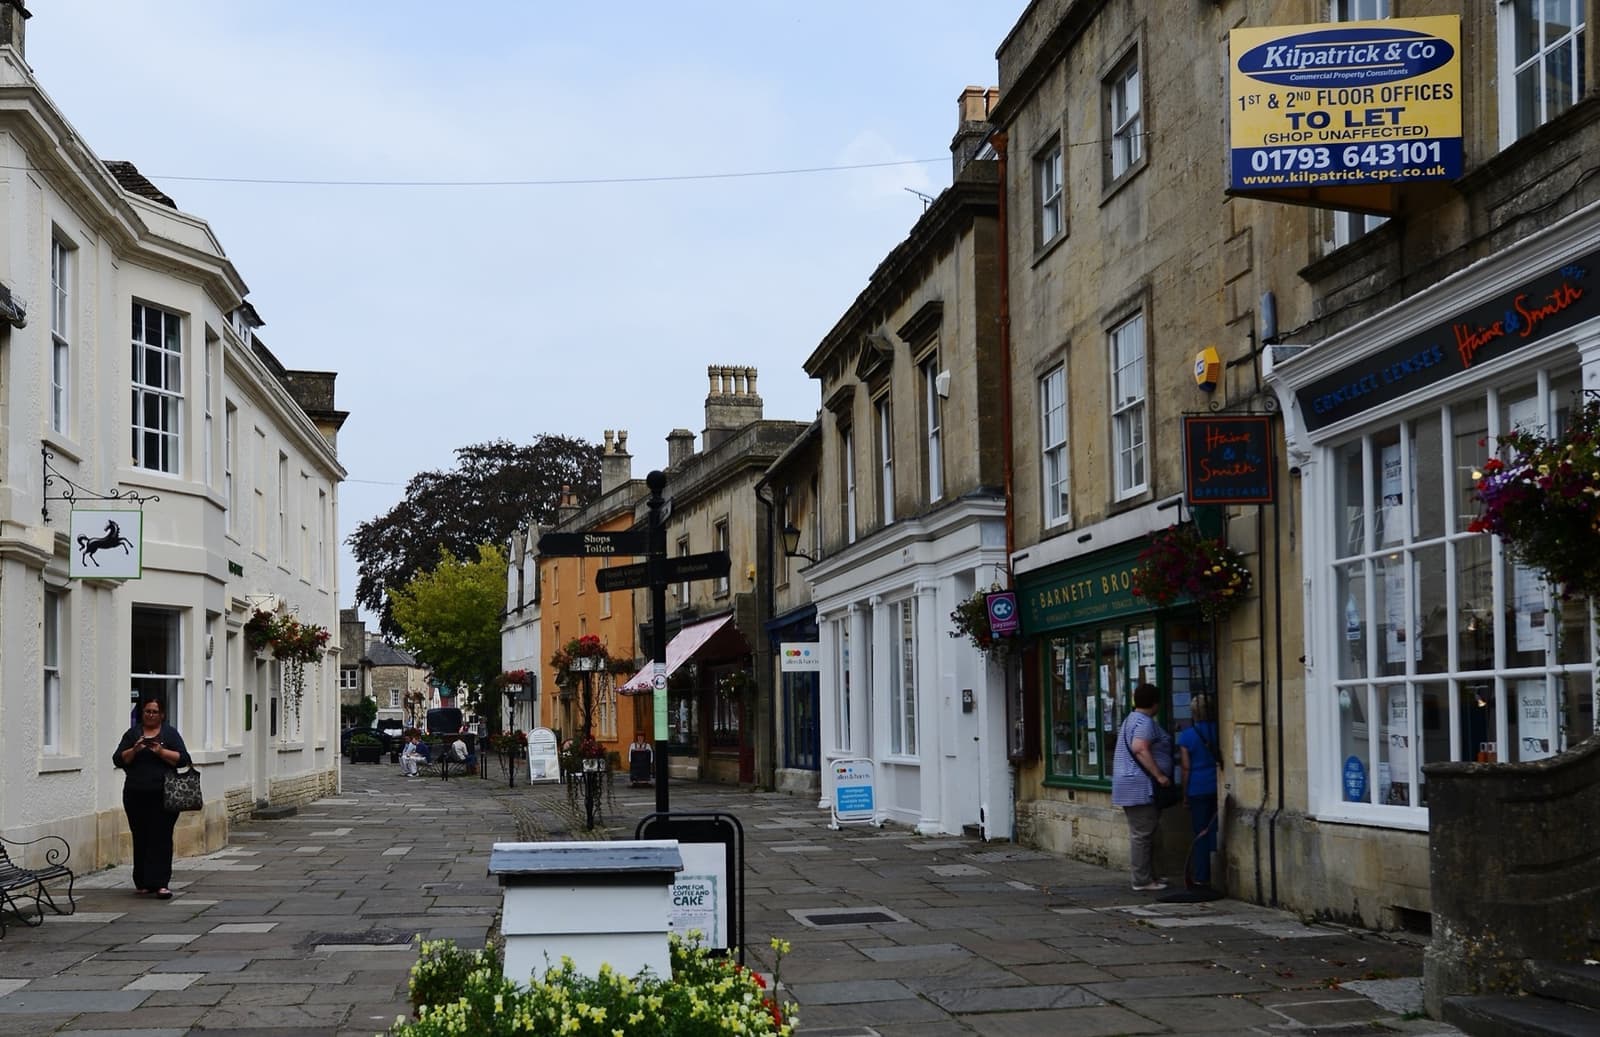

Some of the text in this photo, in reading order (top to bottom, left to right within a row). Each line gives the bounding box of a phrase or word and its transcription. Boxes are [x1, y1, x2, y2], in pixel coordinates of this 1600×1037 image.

[1263, 41, 1436, 69] Kilpatrick & Co
[1290, 68, 1409, 81] Commercial Property Consultants
[1267, 94, 1280, 109] &
[1317, 88, 1375, 106] FLOOR
[1380, 83, 1454, 104] OFFICES
[1286, 107, 1406, 130] TO LET
[1263, 125, 1429, 146] (SHOP UNAFFECTED)
[1251, 141, 1441, 172] 01793 643101
[1242, 165, 1446, 185] www.kilpatrick-cpc.co.uk
[1312, 284, 1584, 415] CONTACT LENSES Haine & Smith
[1205, 424, 1250, 452] Haine
[1223, 446, 1235, 460] &
[1199, 456, 1256, 482] Smith
[584, 534, 610, 544] Shops
[584, 545, 615, 553] Toilets
[1040, 579, 1093, 608] BARNETT
[673, 896, 704, 906] CAKE
